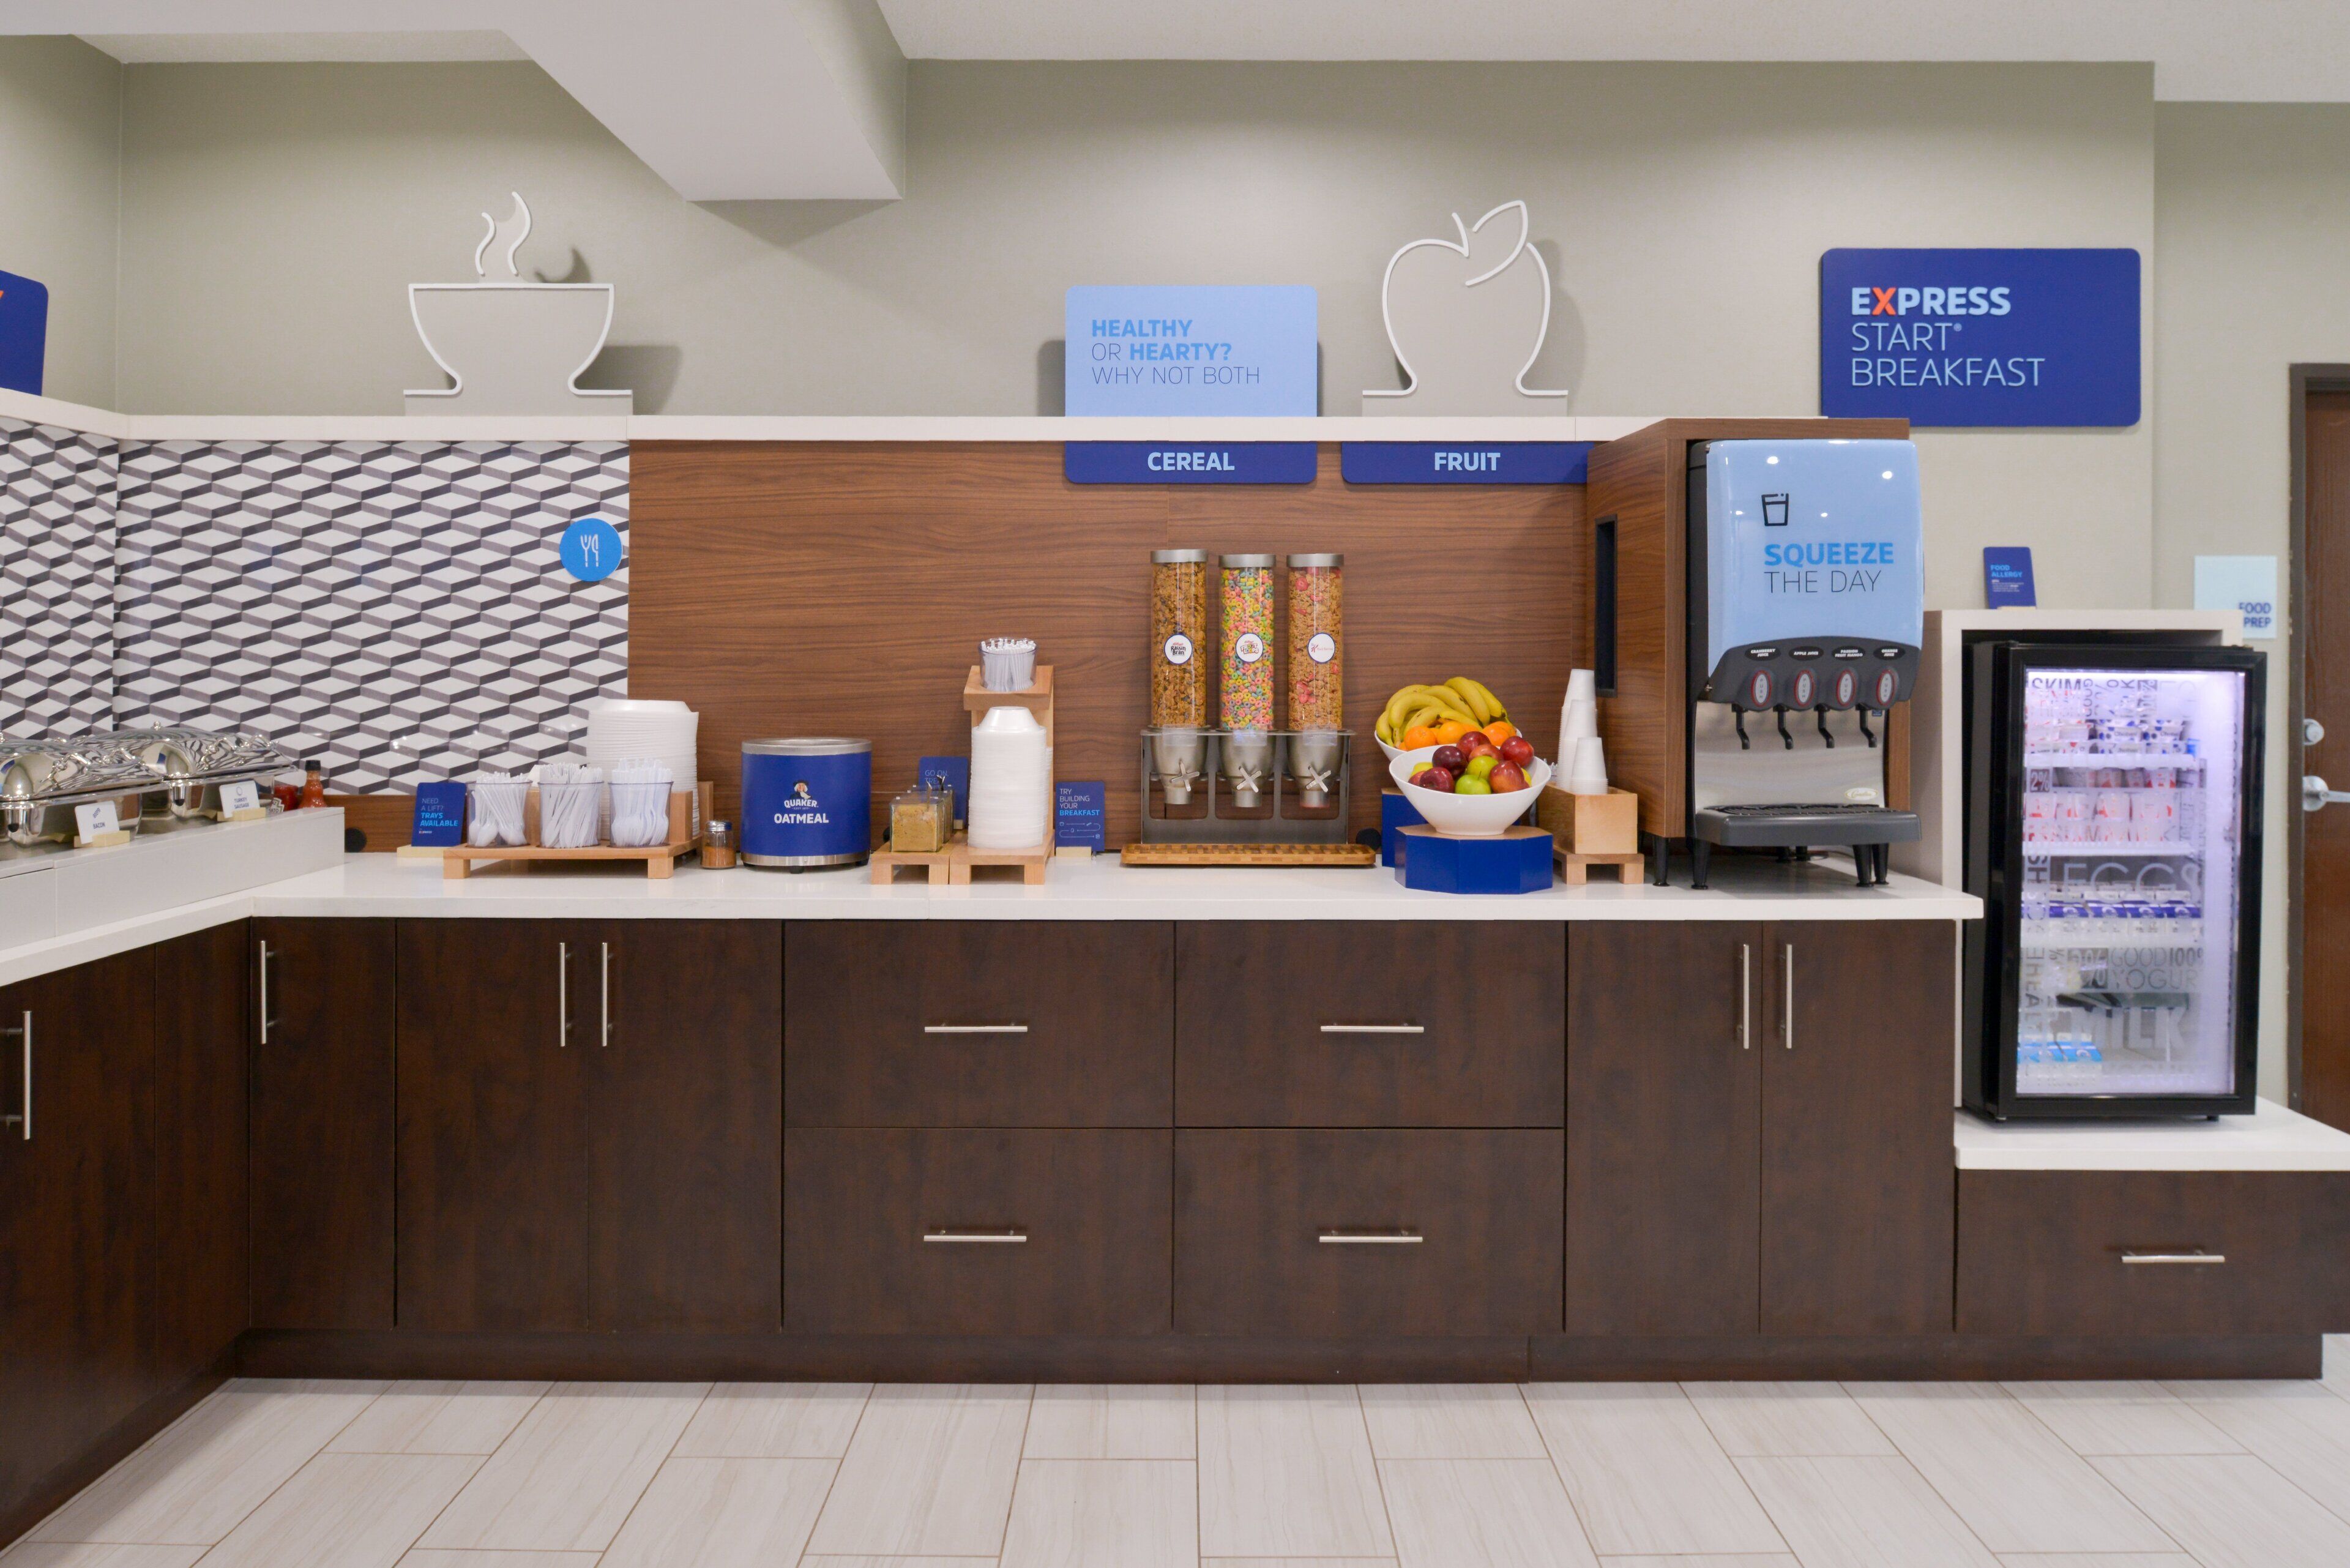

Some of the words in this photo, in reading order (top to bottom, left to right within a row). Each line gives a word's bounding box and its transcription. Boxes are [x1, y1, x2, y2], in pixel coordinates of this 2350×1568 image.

[1852, 286, 2011, 316] EXPRESS
[1092, 319, 1193, 337] HEALTHY
[1092, 343, 1121, 361] OR
[1130, 343, 1232, 361] HEARTY?
[1092, 366, 1143, 384] WHY
[1153, 366, 1195, 384] NOT
[1204, 366, 1259, 384] BOTH
[1852, 357, 2046, 387] BREAKFAST
[1147, 452, 1235, 471] CEREAL
[1434, 452, 1501, 471] FRUIT
[1764, 542, 1894, 568] SQUEEZE
[1764, 570, 1818, 593] THE
[1831, 570, 1881, 592] DAY
[2239, 602, 2271, 614] FOOD
[2243, 617, 2272, 628] PREP
[784, 799, 818, 808] QUAKER
[774, 813, 829, 824] OATMEAL
